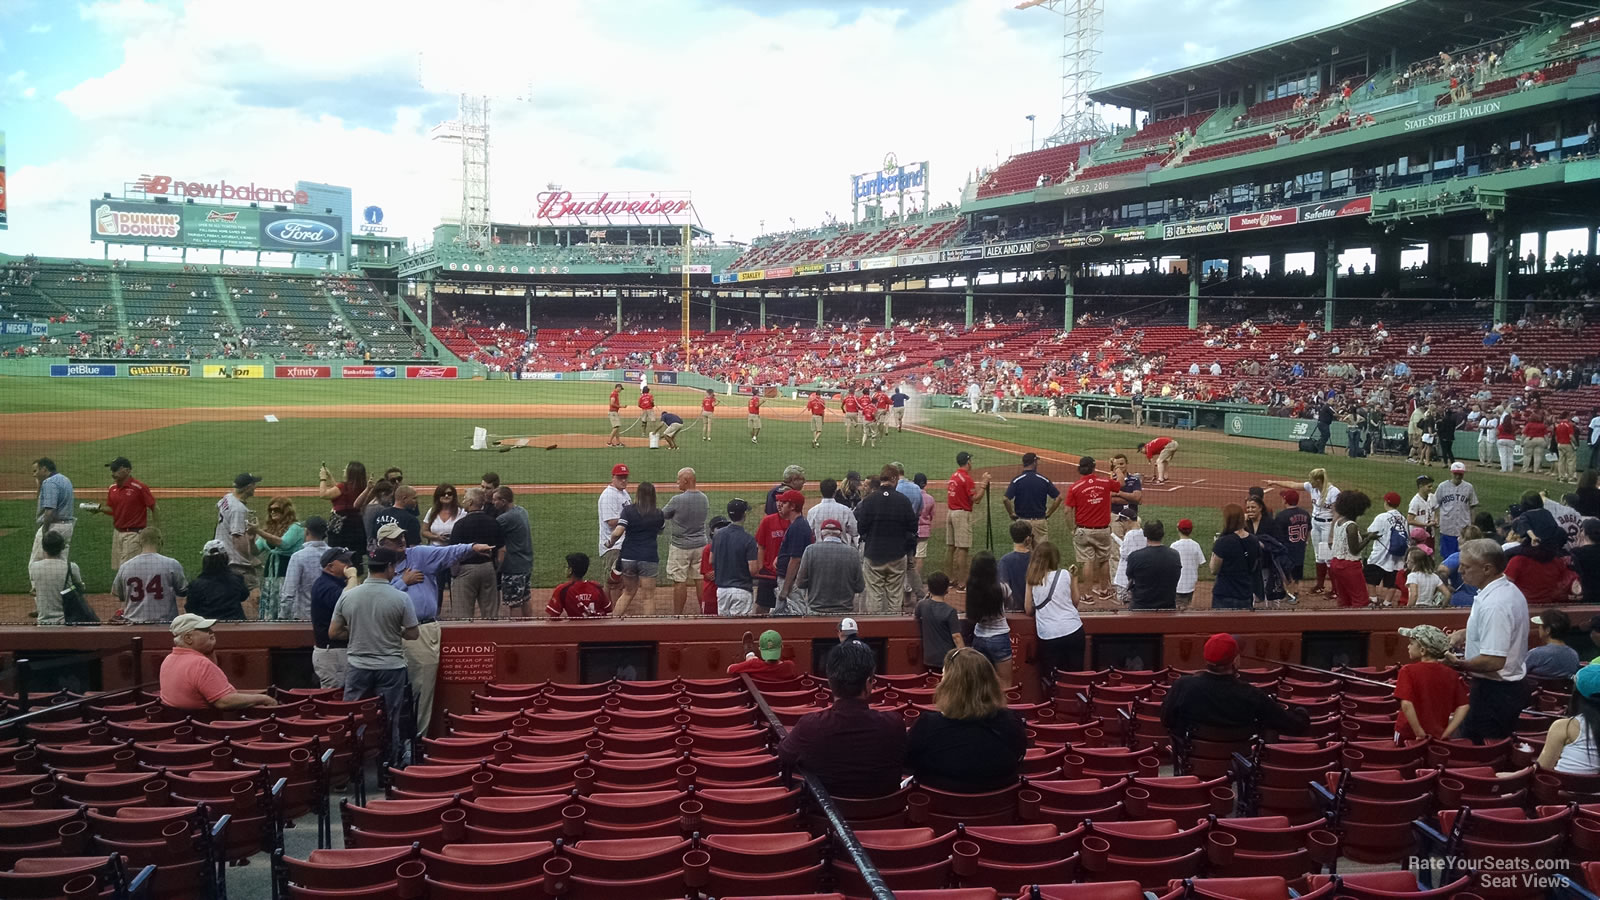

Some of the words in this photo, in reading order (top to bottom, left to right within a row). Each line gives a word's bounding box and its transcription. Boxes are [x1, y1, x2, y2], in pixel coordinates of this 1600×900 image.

[1404, 117, 1427, 131] STATE
[1428, 111, 1457, 125] STREET
[1460, 101, 1501, 119] PAVILION
[174, 181, 219, 198] new
[221, 180, 308, 204] balance
[1064, 185, 1080, 196] JUNE
[1081, 184, 1092, 193] 22,
[1093, 181, 1109, 191] 2016
[536, 191, 689, 219] Budweiser
[120, 213, 178, 225] DUNKIN'
[1241, 217, 1259, 226] Ninety
[1269, 214, 1283, 222] Nine
[1304, 209, 1336, 220] Safelite
[120, 224, 176, 236] DONUTS
[281, 223, 324, 241] Ford
[1176, 226, 1186, 235] The
[1186, 224, 1206, 234] Boston
[1206, 222, 1224, 232] Globe
[987, 246, 1003, 256] ALEX
[1003, 244, 1019, 254] AND
[742, 272, 760, 280] STANLEY
[67, 365, 100, 376] jetBlue
[130, 366, 168, 376] GRANITE
[170, 366, 190, 376] CITY
[287, 367, 319, 378] xfinity
[1288, 524, 1308, 543] 50
[126, 574, 164, 602] 34
